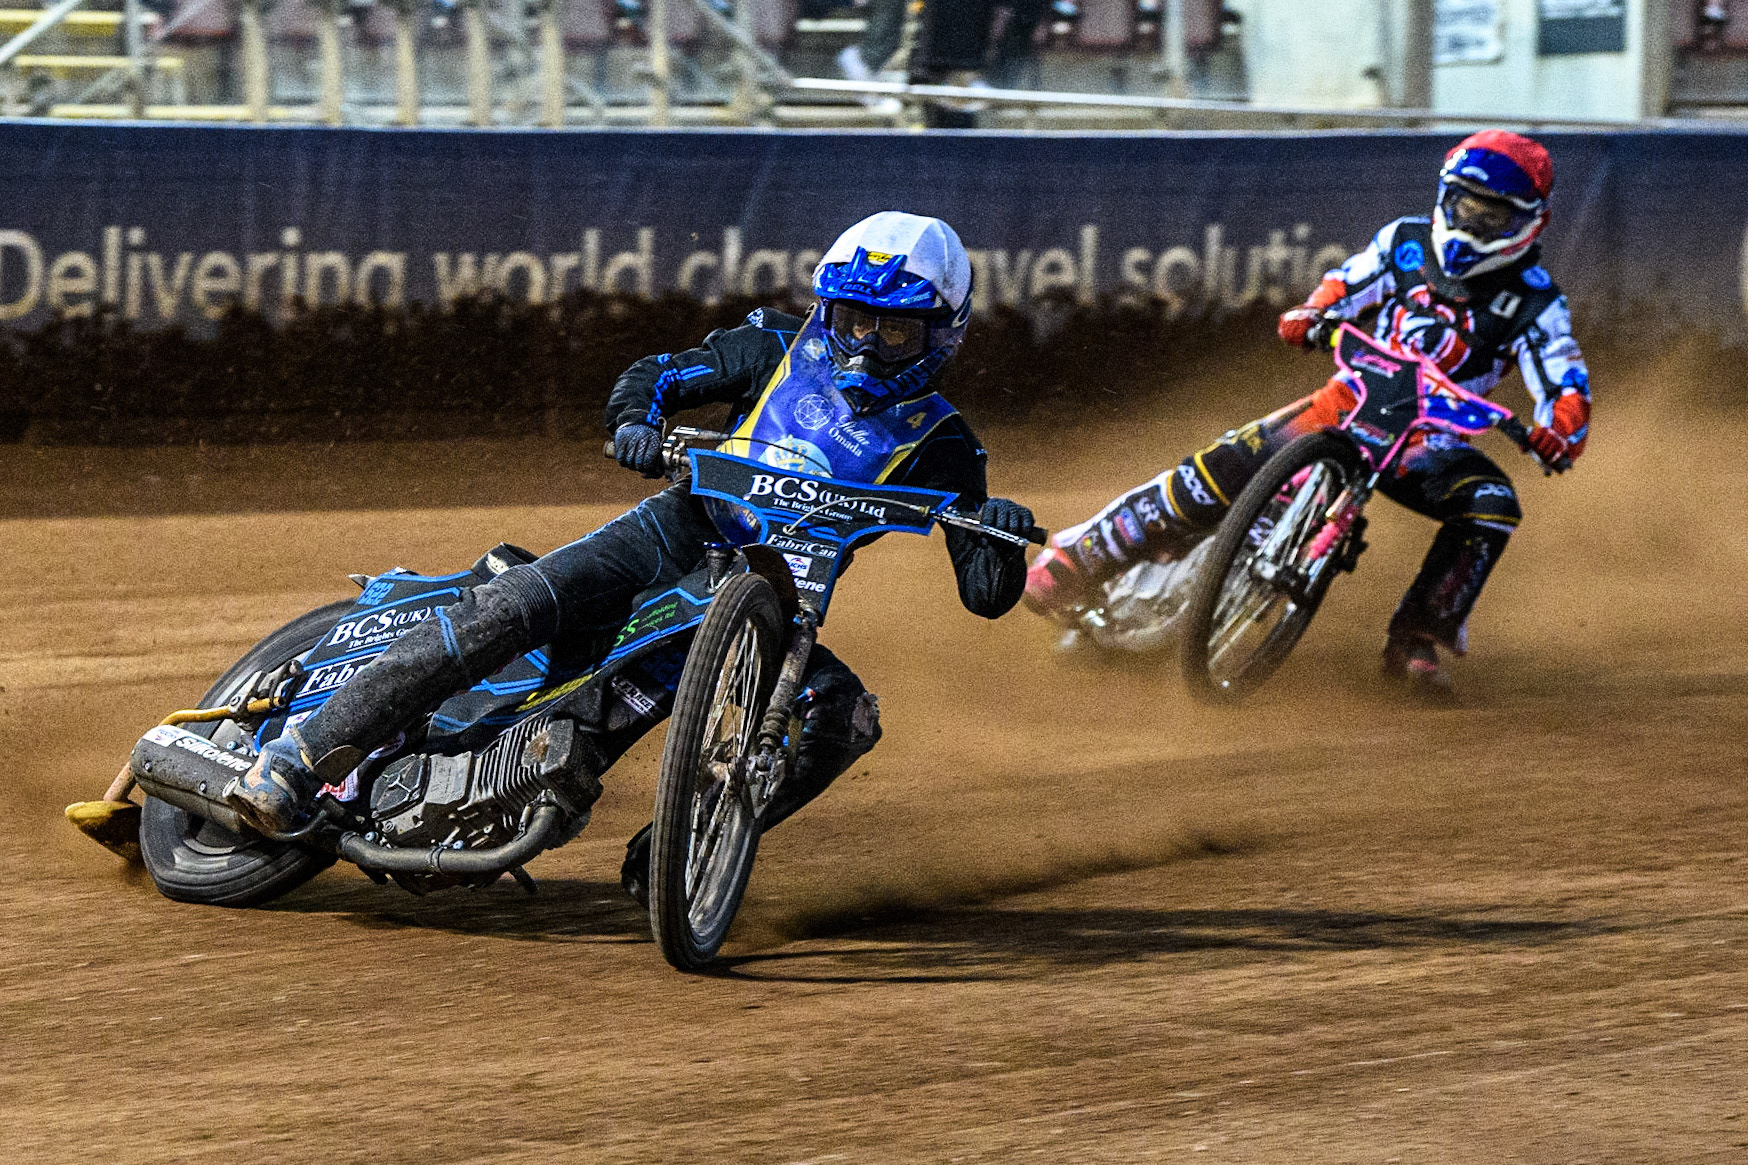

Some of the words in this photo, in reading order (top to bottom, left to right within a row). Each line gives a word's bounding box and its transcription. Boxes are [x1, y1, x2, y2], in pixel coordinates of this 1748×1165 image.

[432, 226, 655, 308] world
[678, 226, 821, 304] clas
[1121, 222, 1348, 308] solutio
[906, 411, 927, 429] 4
[828, 427, 863, 458] Omada
[860, 502, 887, 518] Ltd
[766, 534, 838, 558] FabriCan
